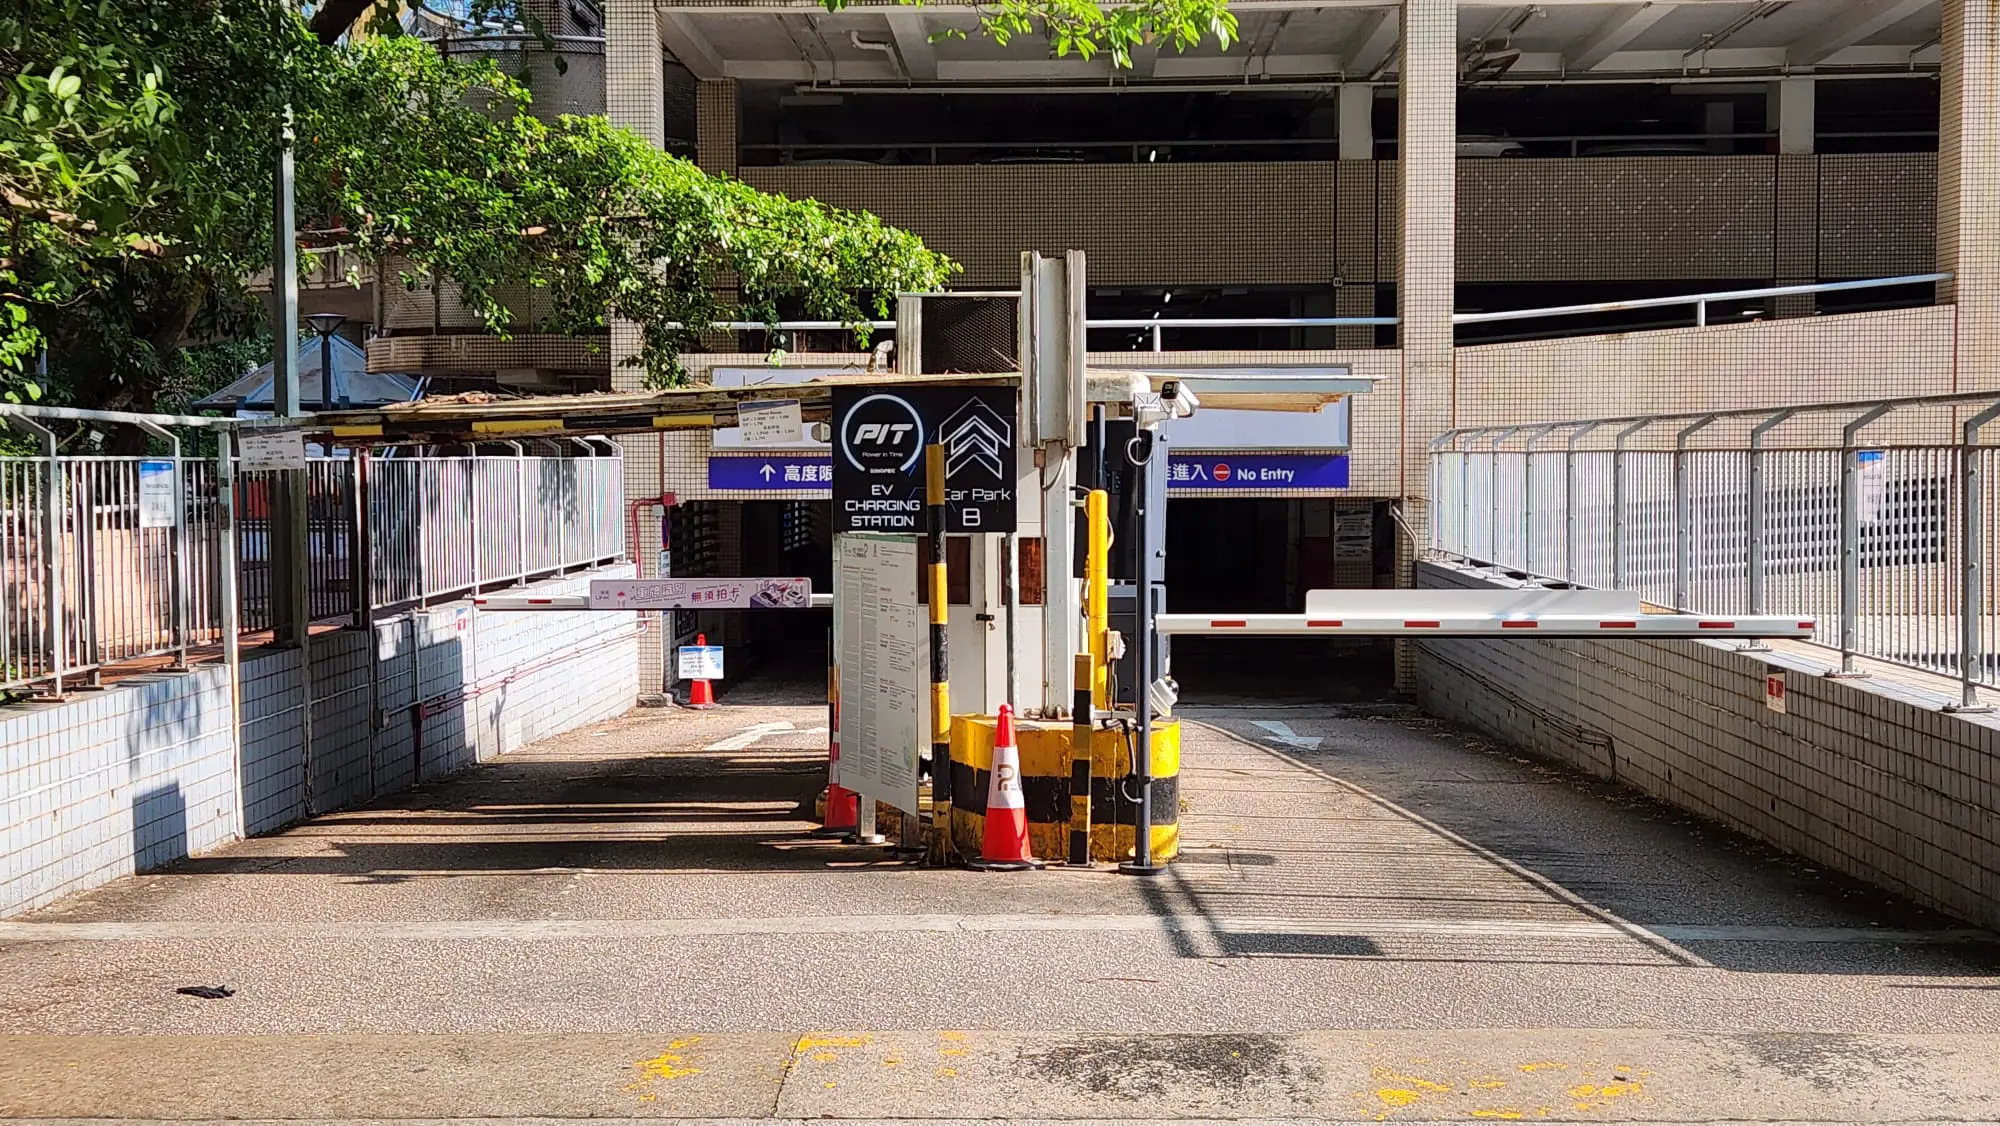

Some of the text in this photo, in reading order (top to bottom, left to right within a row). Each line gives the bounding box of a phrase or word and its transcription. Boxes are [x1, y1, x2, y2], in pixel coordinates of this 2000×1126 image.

[853, 424, 913, 445] PIT
[784, 464, 832, 482] 高度限
[1167, 463, 1208, 481] 進入
[1237, 467, 1295, 483] No Entry
[871, 484, 894, 496] EV
[972, 488, 1011, 500] Park
[845, 500, 921, 512] CHARGING
[851, 515, 915, 527] STATION
[962, 508, 981, 526] B
